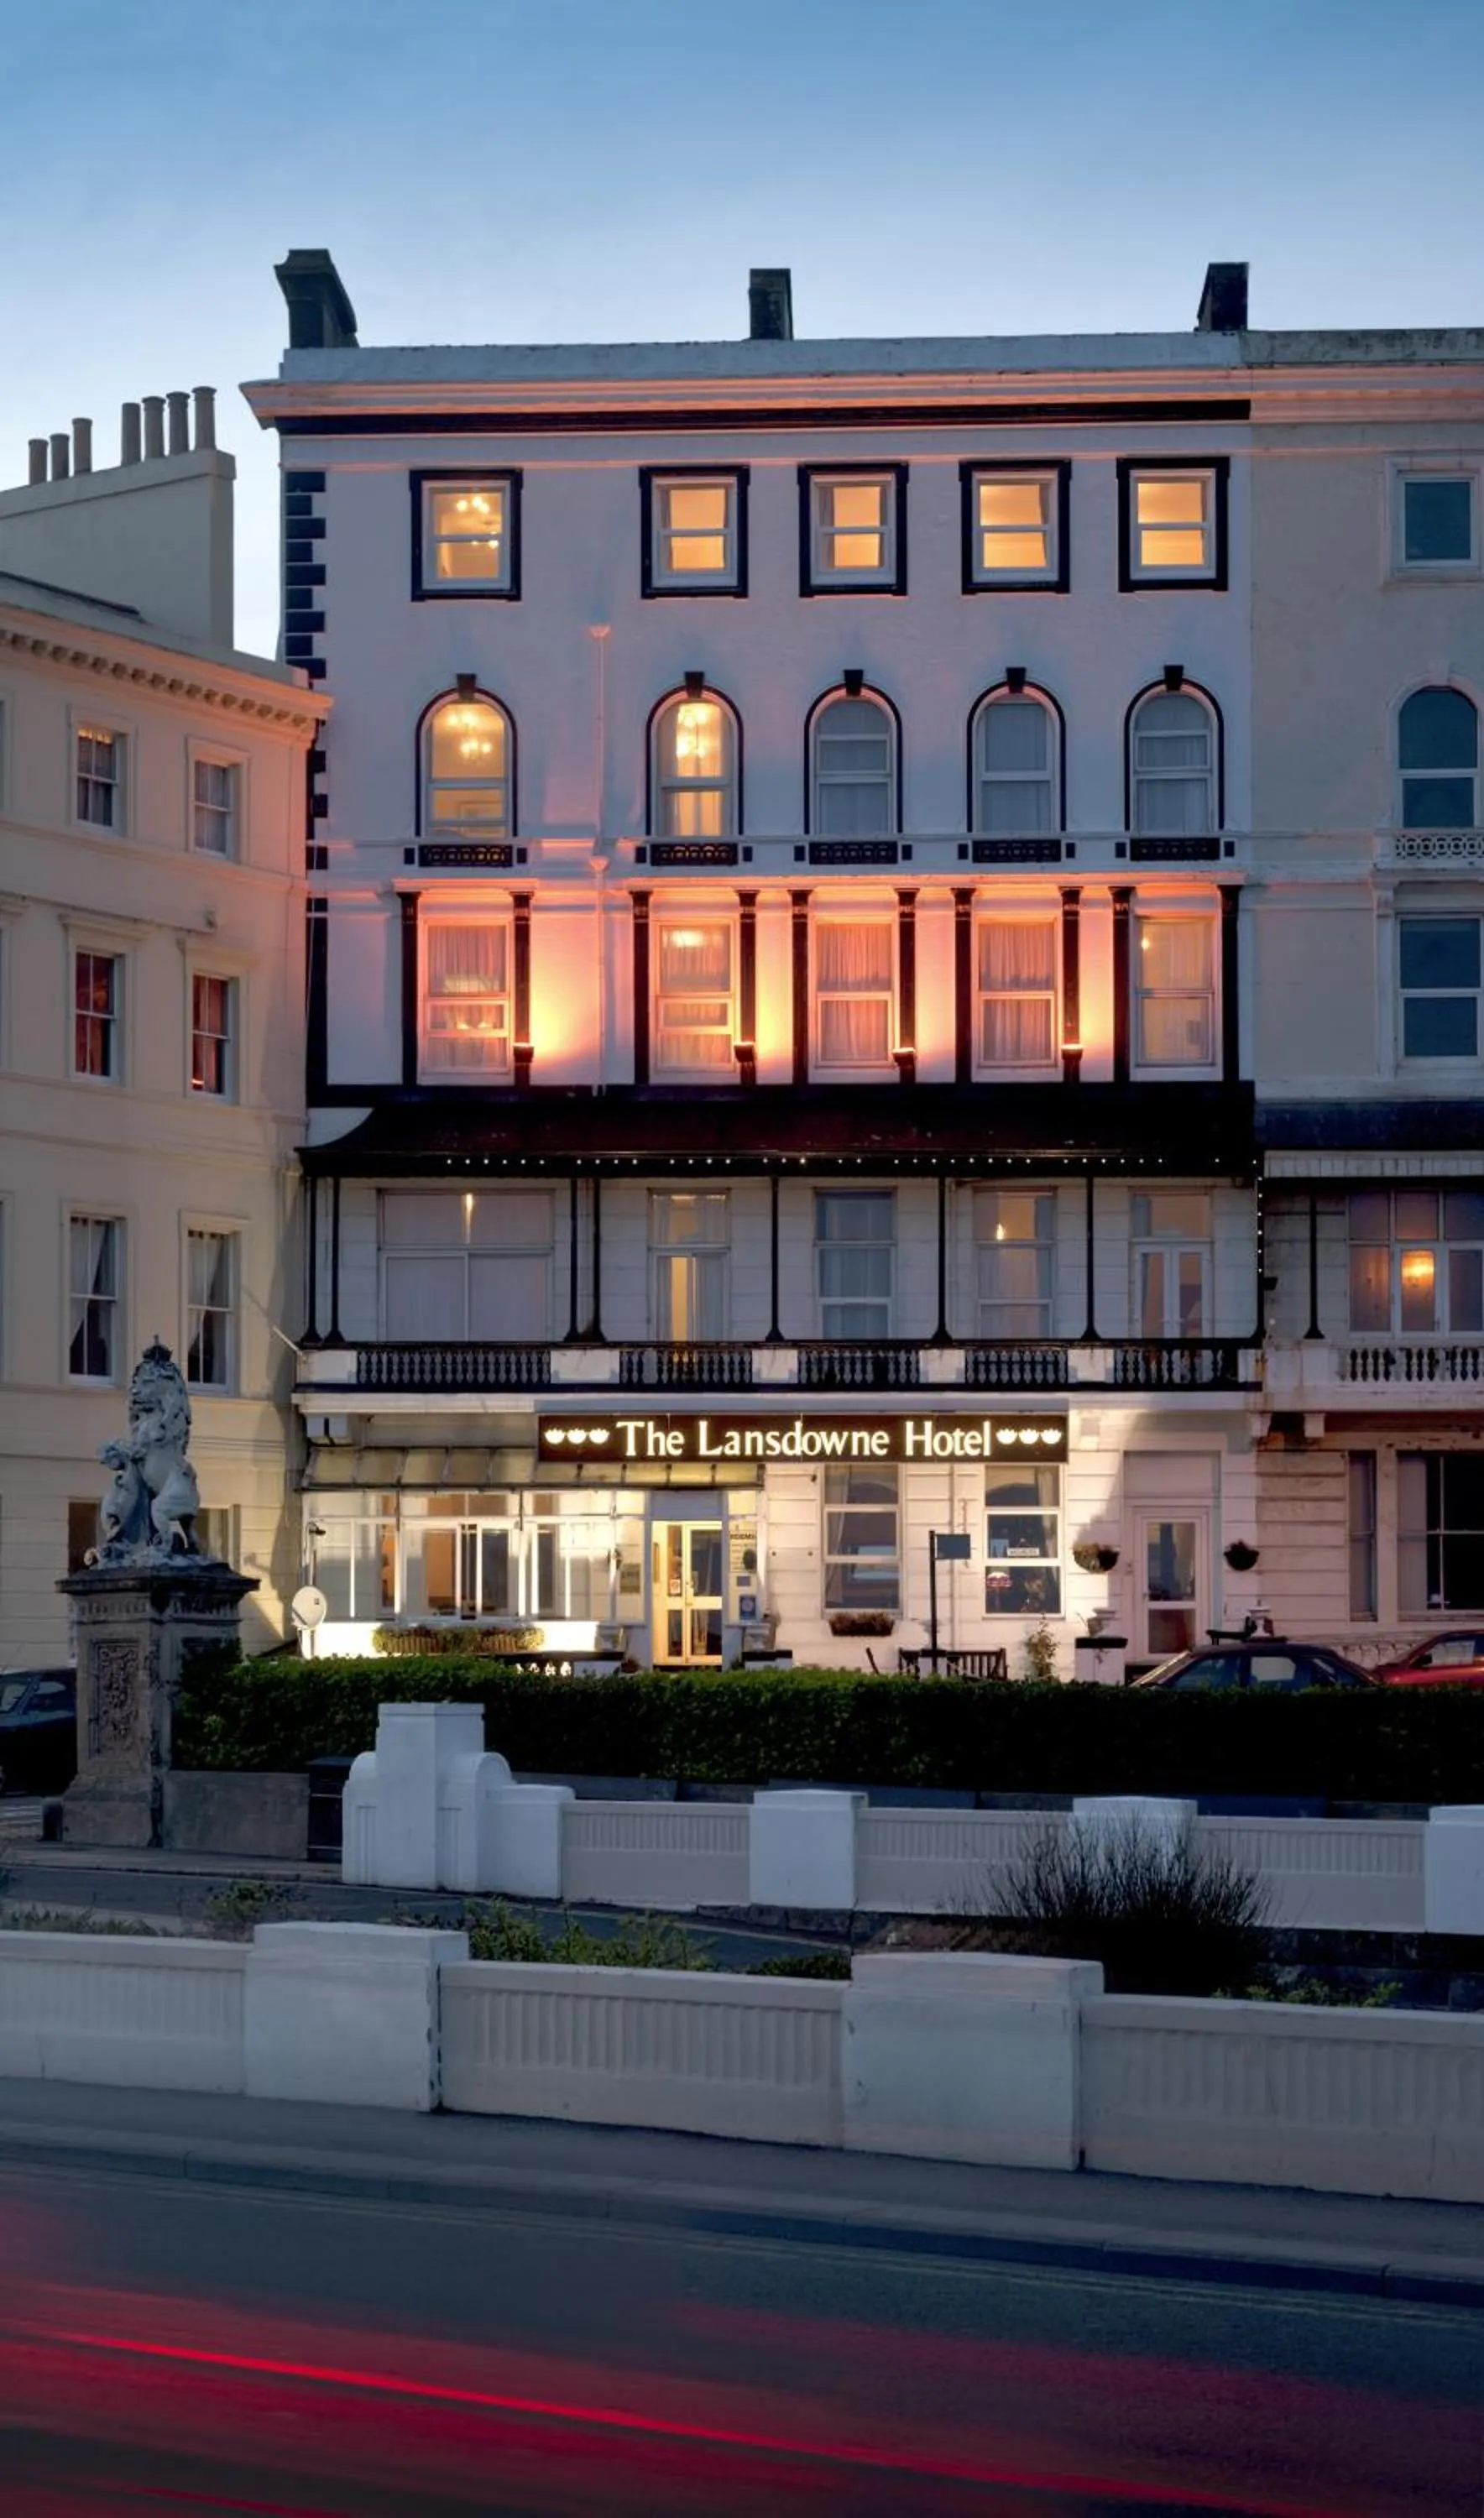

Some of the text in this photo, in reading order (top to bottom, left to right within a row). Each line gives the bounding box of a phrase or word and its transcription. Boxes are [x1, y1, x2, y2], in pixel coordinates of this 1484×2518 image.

[616, 1420, 991, 1456] The Lansdowne Hotel
